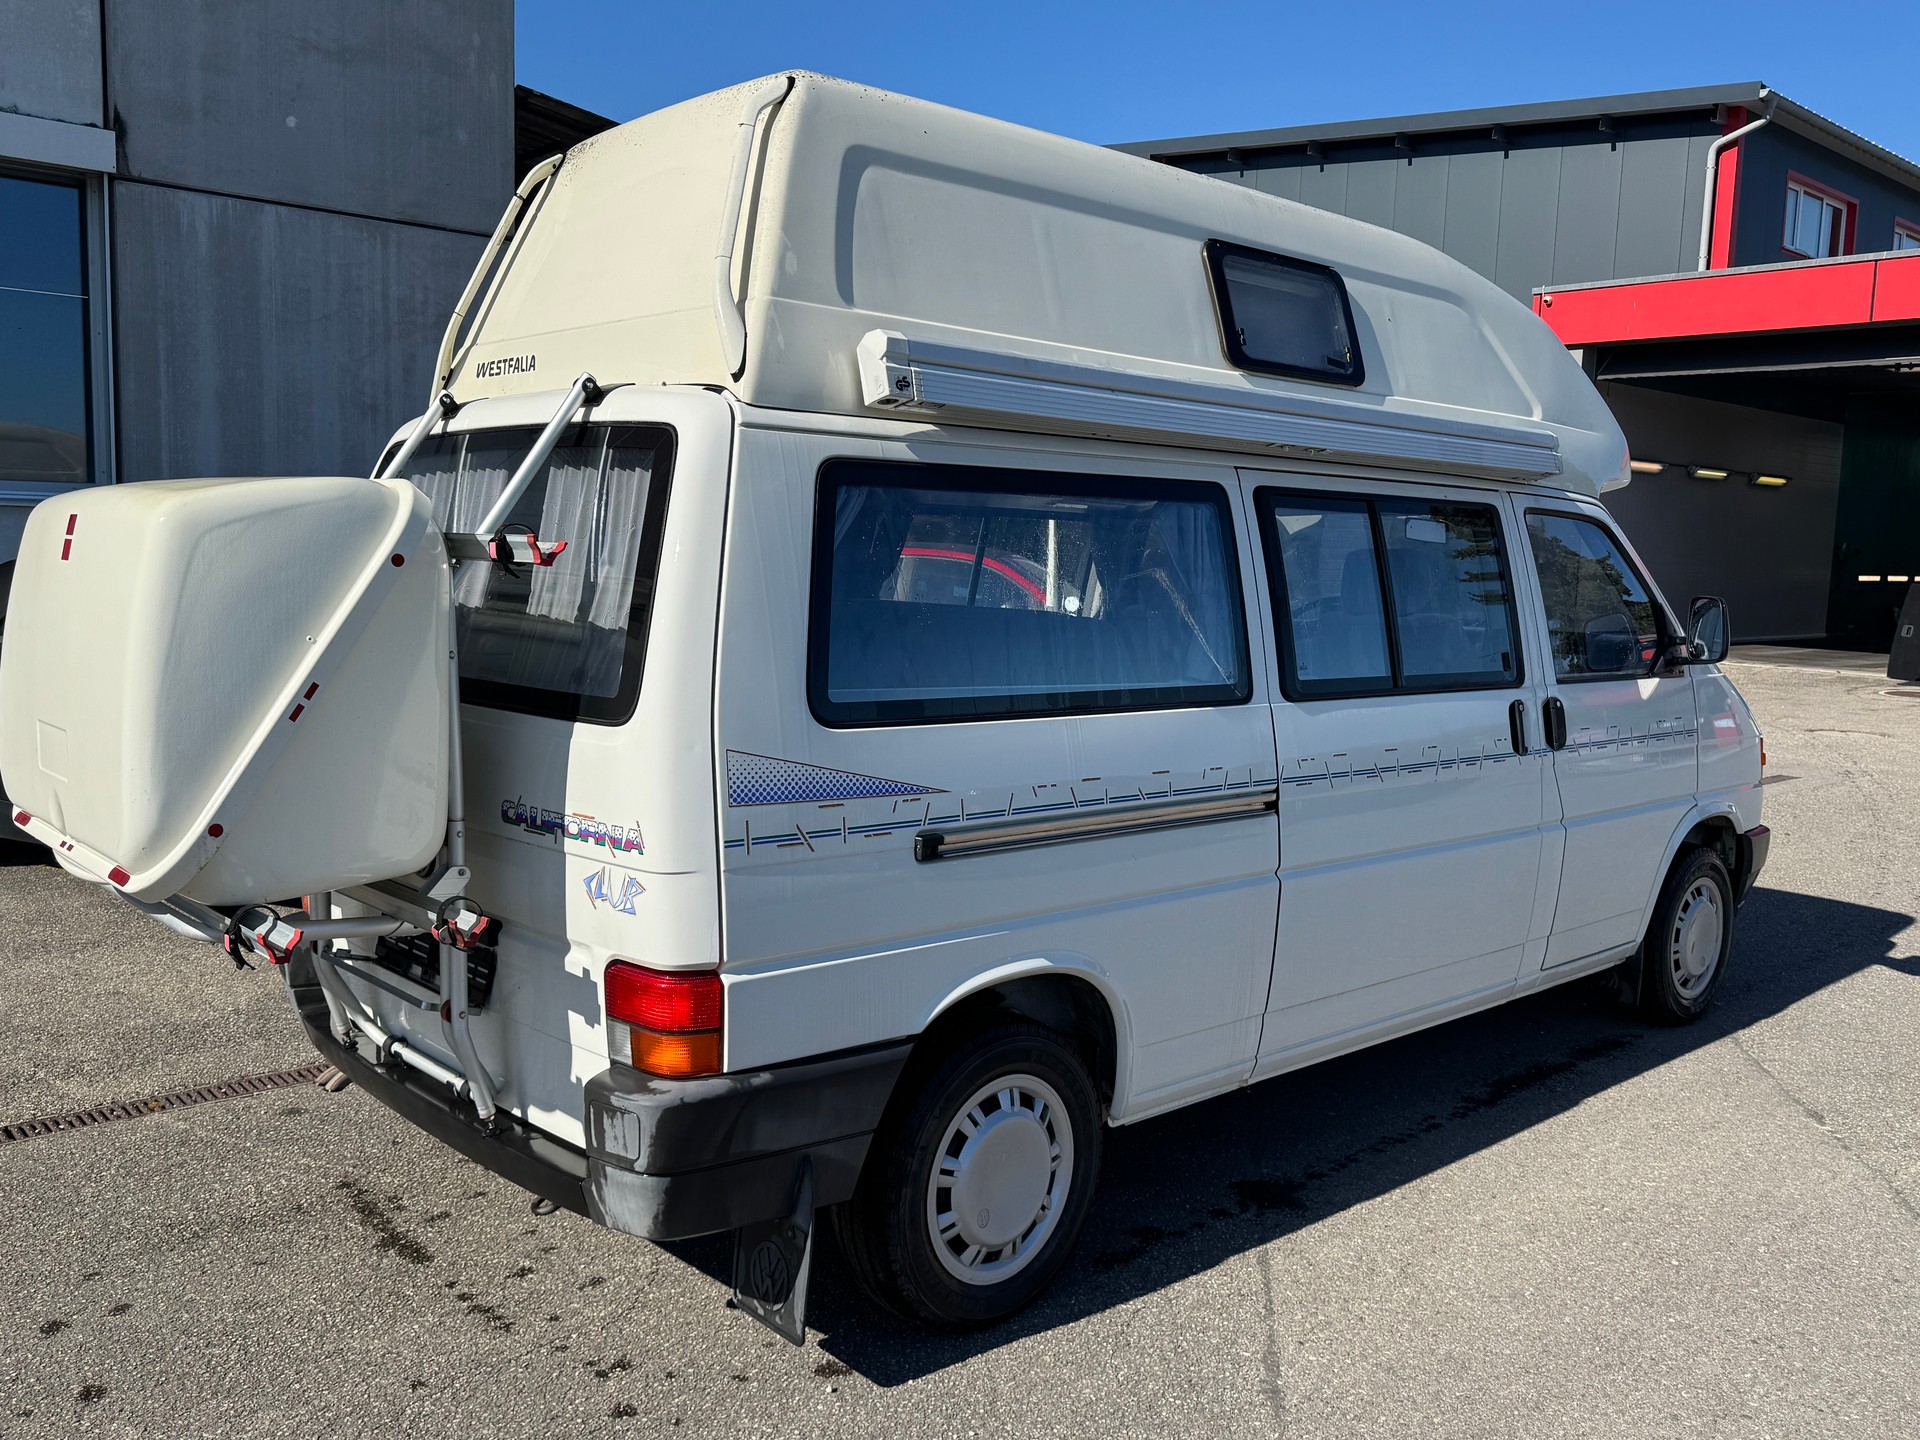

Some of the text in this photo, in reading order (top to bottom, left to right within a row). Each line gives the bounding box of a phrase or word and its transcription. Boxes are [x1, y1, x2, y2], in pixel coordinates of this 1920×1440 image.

[476, 354, 536, 378] WESTFALIA
[501, 799, 644, 855] CALIFORNIA
[583, 866, 646, 915] CLUB
